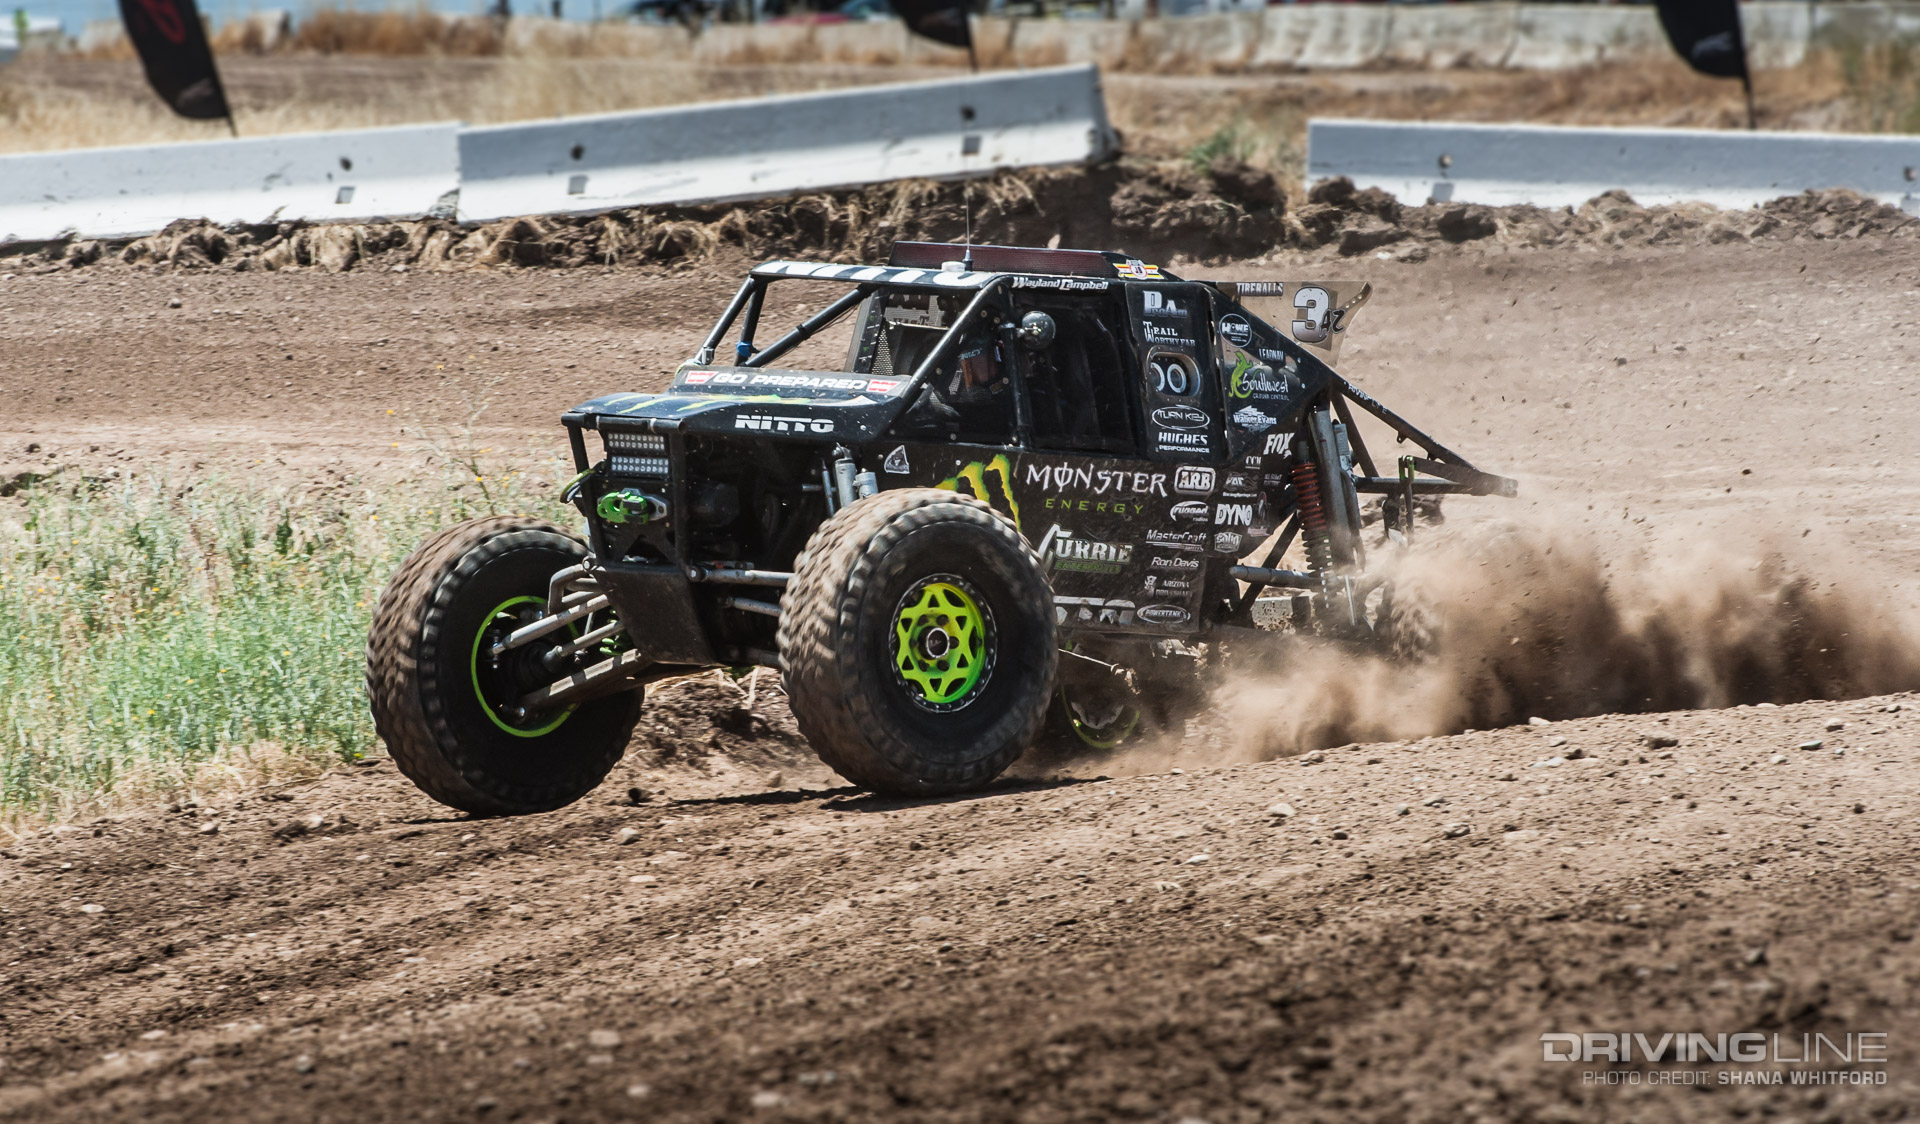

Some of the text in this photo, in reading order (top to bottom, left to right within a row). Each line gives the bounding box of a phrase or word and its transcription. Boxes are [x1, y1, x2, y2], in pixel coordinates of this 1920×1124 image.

[1012, 276, 1109, 291] Wayland Campbell
[1292, 286, 1330, 343] 3
[713, 373, 867, 390] GO PREPARED
[1242, 373, 1289, 393] Southwest
[734, 414, 834, 433] NITTO
[1157, 410, 1183, 420] TURN
[1158, 432, 1208, 445] HUGHES
[1263, 433, 1295, 456] FOX
[1158, 444, 1210, 454] PERFORMANCE
[1178, 471, 1211, 490] ARB
[1045, 498, 1144, 514] ENERGY
[1214, 503, 1253, 526] DYNO
[1146, 529, 1207, 543] MasterCraft
[1036, 523, 1133, 575] CURRIE
[1151, 556, 1200, 568] Ron Davis
